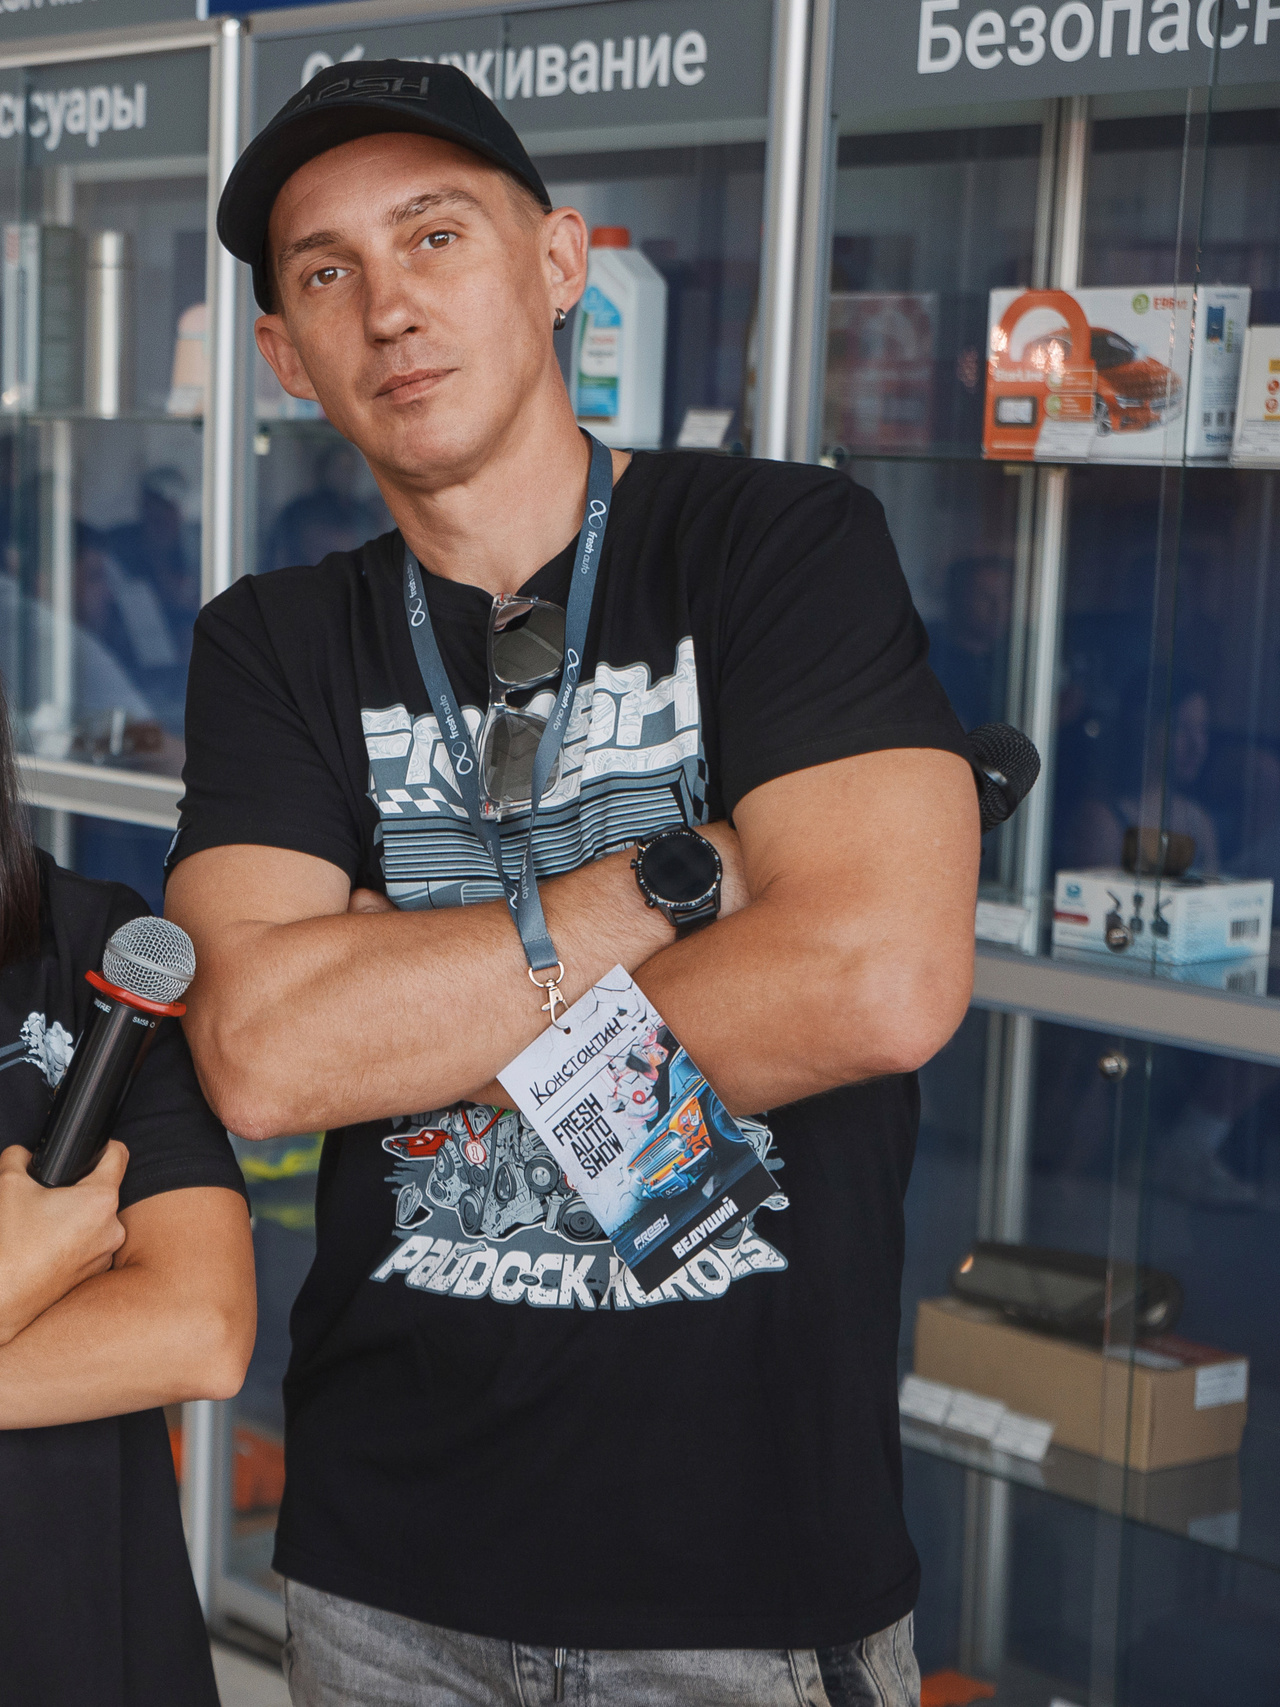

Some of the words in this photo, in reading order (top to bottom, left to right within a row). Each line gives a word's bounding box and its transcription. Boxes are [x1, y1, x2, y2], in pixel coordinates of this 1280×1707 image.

[301, 29, 708, 100] Оживание
[584, 531, 597, 553] fresh
[581, 553, 591, 575] auto
[439, 695, 451, 716] auto
[561, 683, 573, 709] fresh
[445, 715, 460, 739] fresh
[553, 708, 565, 731] auto
[529, 1016, 623, 1106] Константин
[552, 1092, 604, 1147] FRESH
[570, 1114, 613, 1163] AUTO
[580, 1132, 625, 1180] SHOW
